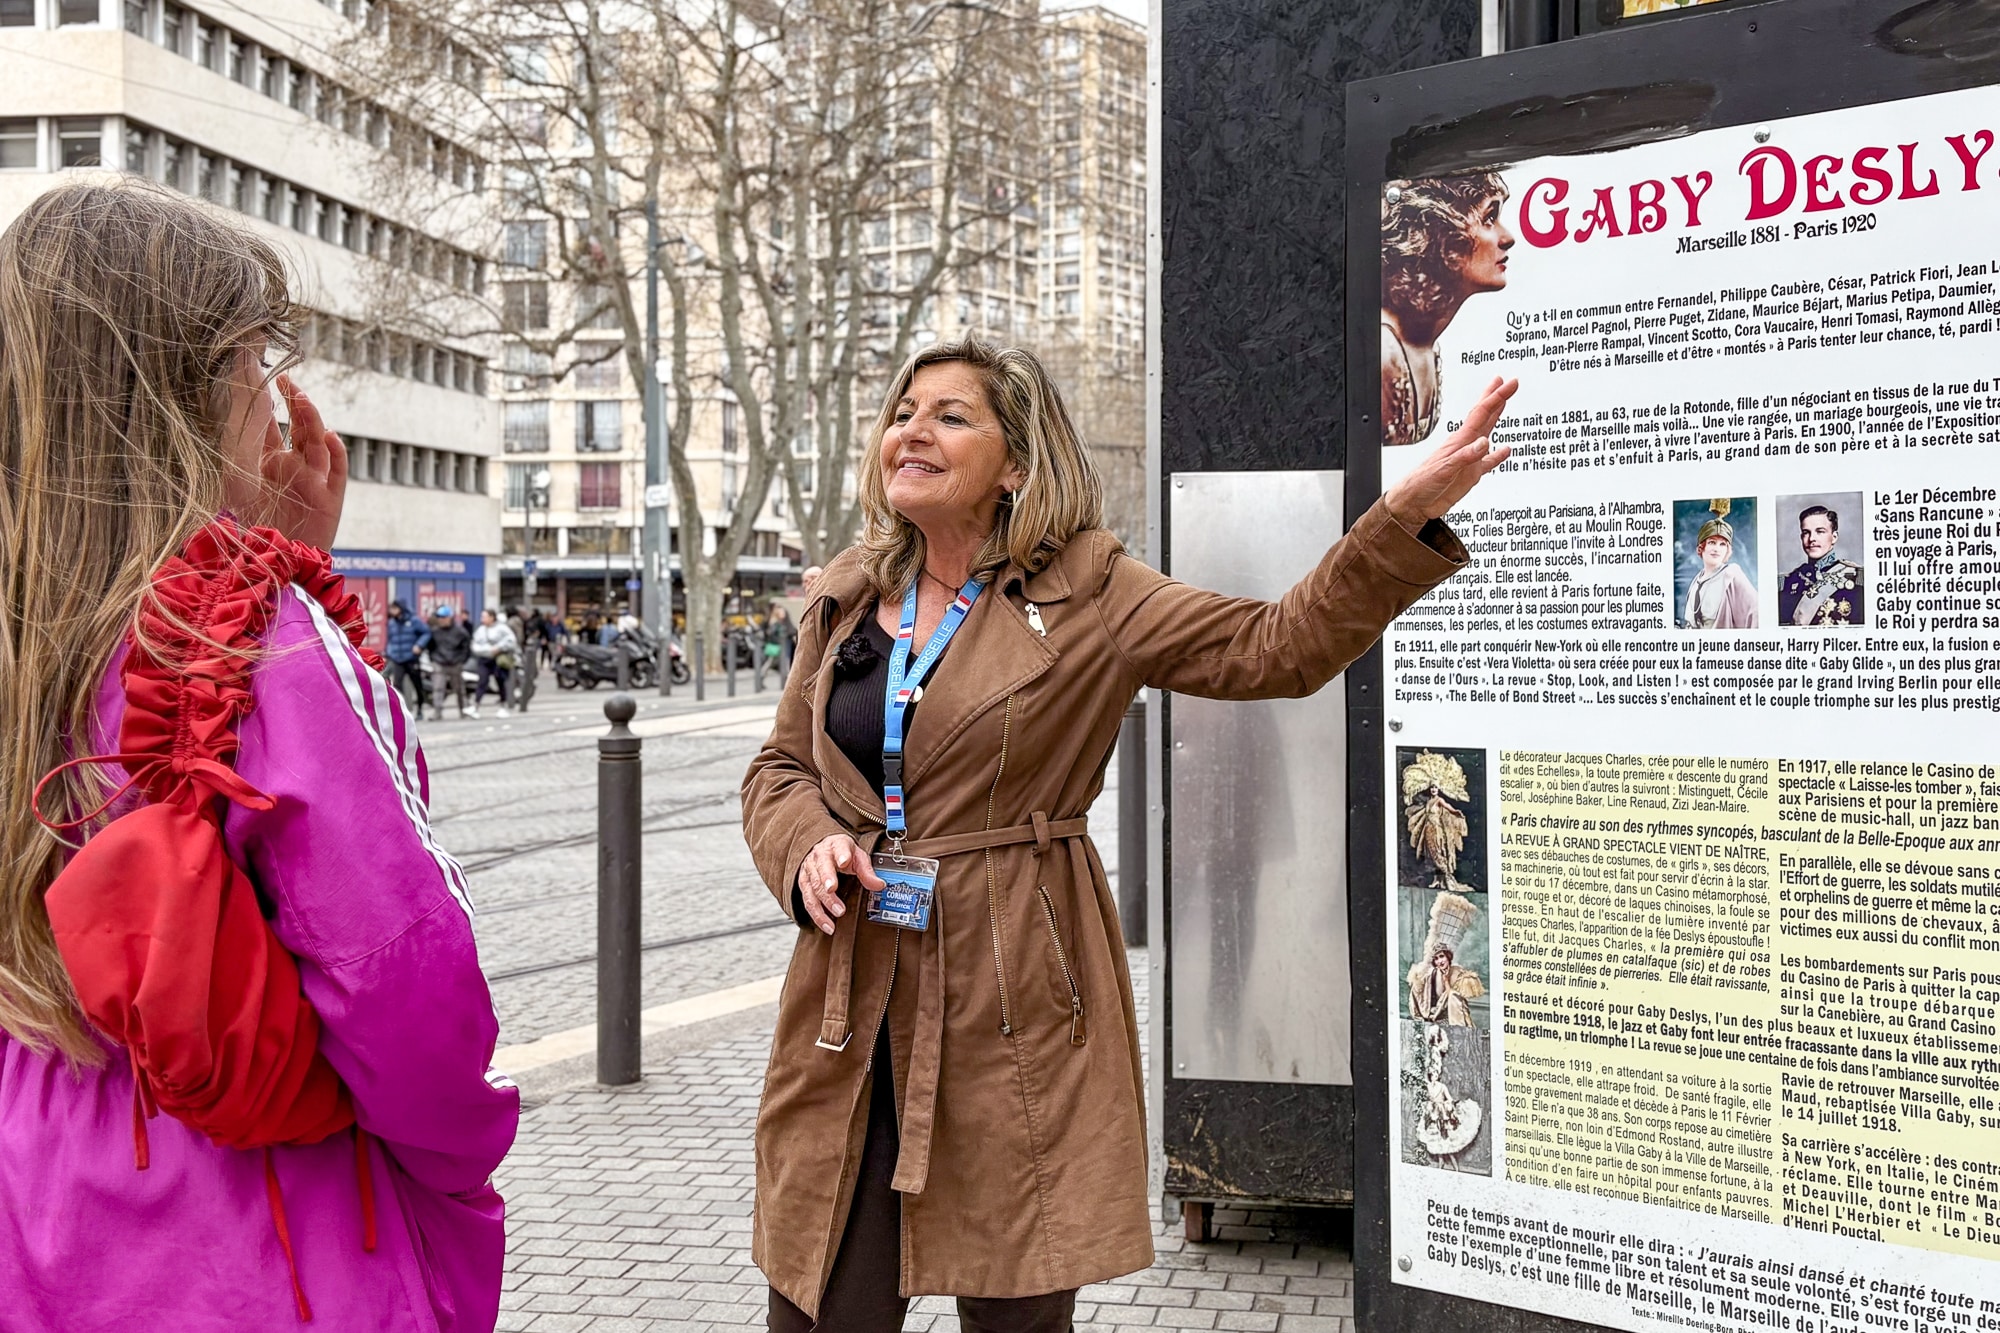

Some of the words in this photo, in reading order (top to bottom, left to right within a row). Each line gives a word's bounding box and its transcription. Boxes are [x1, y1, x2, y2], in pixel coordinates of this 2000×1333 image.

[1519, 170, 1712, 248] GABY
[1739, 130, 2000, 220] DESLY
[1676, 230, 1746, 253] Marseille
[1751, 225, 1780, 245] 1881
[1794, 219, 1838, 239] Paris
[1842, 213, 1876, 234] 1920
[1534, 313, 1539, 322] a
[1560, 310, 1572, 320] en
[1576, 304, 1621, 318] commun
[1625, 299, 1653, 312] entre
[1658, 291, 1716, 309] Fernandel,
[1721, 288, 1767, 302] Philippe
[1771, 281, 1823, 297] Caubère,
[1828, 277, 1866, 291] César,
[1871, 270, 1916, 286] Patrick
[1920, 266, 1952, 281] Fiori,
[1957, 265, 1986, 277] Jean
[1506, 329, 1550, 344] Soprano,
[1554, 322, 1588, 337] Marcel
[1592, 318, 1630, 335] Pagnol,
[1634, 316, 1666, 329] Pierre
[1670, 310, 1704, 327] Puget,
[1708, 308, 1749, 321] Zidane,
[1753, 302, 1799, 317] Maurice
[1803, 296, 1842, 313] Béjart,
[1847, 293, 1887, 307] Marius
[1892, 288, 1934, 303] Petipa,
[1939, 282, 1995, 298] Daumier,
[1462, 350, 1495, 365] Régine
[1498, 345, 1538, 360] Crespin,
[1541, 340, 1598, 356] Jean-Pierre
[1602, 334, 1644, 350] Rampal,
[1648, 329, 1689, 345] Vincent
[1692, 326, 1731, 341] Scotto,
[1735, 324, 1760, 337] Cora
[1764, 318, 1817, 334] Vaucaire,
[1822, 314, 1852, 328] Henri
[1856, 309, 1902, 325] Tomasi,
[1907, 303, 1964, 321] Raymond
[1968, 300, 2000, 315] Allèg
[1490, 427, 1561, 443] Conservatoire
[1565, 426, 1577, 438] de
[1581, 422, 1630, 437] Marseille
[1634, 420, 1659, 433] mais
[1663, 418, 1698, 431] voilà...
[1703, 416, 1724, 428] Une
[1728, 414, 1744, 426] vie
[1748, 411, 1791, 427] rangée,
[1796, 412, 1809, 422] un
[1814, 407, 1862, 421] mariage
[1867, 401, 1931, 418] bourgeois,
[1936, 402, 1959, 412] une
[1964, 398, 1982, 410] vie
[1986, 397, 2000, 409] tra
[1875, 491, 1890, 505] Le
[1895, 490, 1918, 504] 1er
[1923, 487, 1996, 503] Décembre
[1873, 525, 1899, 540] très
[1904, 526, 1942, 543] jeune
[1946, 524, 1969, 538] Roi
[1974, 522, 1991, 537] du
[1394, 619, 1446, 633] immenses,
[1450, 618, 1464, 630] les
[1468, 618, 1501, 633] perles,
[1506, 618, 1515, 630] et
[1519, 618, 1533, 630] les
[1537, 618, 1588, 630] costumes
[1592, 617, 1666, 632] extravagants.
[911, 622, 953, 678] MARSEILLE
[1395, 640, 1406, 652] En
[1409, 640, 1437, 654] 1911,
[1440, 640, 1458, 652] elle
[1461, 640, 1480, 654] part
[1484, 640, 1532, 654] conquérir
[1535, 640, 1582, 652] New-York
[1586, 640, 1598, 652] où
[1602, 640, 1621, 652] elle
[1625, 640, 1678, 651] rencontre
[1682, 642, 1694, 651] un
[1698, 639, 1730, 654] jeune
[1734, 639, 1783, 653] danseur,
[1788, 639, 1819, 654] Harry
[1824, 639, 1861, 651] Pilcer.
[1866, 639, 1898, 651] Entre
[1902, 641, 1928, 653] eux,
[1933, 639, 1944, 651] la
[1948, 639, 1988, 651] fusion
[1500, 750, 1510, 761] Le
[1514, 751, 1562, 763] décorateur
[1564, 752, 1602, 766] Jacques
[1606, 754, 1644, 768] Charles,
[1648, 756, 1669, 766] crée
[1673, 758, 1694, 770] pour
[1698, 757, 1714, 768] elle
[1719, 758, 1726, 768] le
[1731, 759, 1768, 770] numéro
[1779, 759, 1794, 772] En
[1799, 759, 1830, 776] 1917,
[1835, 761, 1856, 774] elle
[1861, 762, 1907, 776] relance
[1912, 763, 1923, 776] le
[1928, 763, 1974, 778] Casino
[1978, 765, 1994, 779] de
[1501, 832, 1513, 844] LA
[1516, 833, 1550, 847] REVUE
[1553, 834, 1560, 847] À
[1563, 836, 1600, 850] GRAND
[1604, 839, 1666, 854] SPECTACLE
[1670, 843, 1702, 856] VIENT
[1706, 845, 1720, 857] DE
[1725, 845, 1769, 862] NAÎTRE,
[1782, 1104, 1793, 1118] le
[1798, 1106, 1814, 1120] 14
[1818, 1109, 1857, 1126] juillet
[1862, 1115, 1900, 1132] 1918.
[1783, 1215, 1828, 1233] d'Henri
[1832, 1222, 1885, 1242] Pouctal.
[1428, 1244, 1456, 1267] Gaby
[1462, 1251, 1506, 1277] Deslys,
[1511, 1262, 1542, 1281] c'est
[1547, 1271, 1569, 1286] une
[1574, 1273, 1600, 1292] fille
[1606, 1279, 1621, 1296] de
[1626, 1282, 1696, 1314] Marseille,
[1703, 1297, 1714, 1314] le
[1720, 1300, 1790, 1329] Marseille
[1796, 1318, 1814, 1333] de
[1657, 1312, 1684, 1325] Mireille
